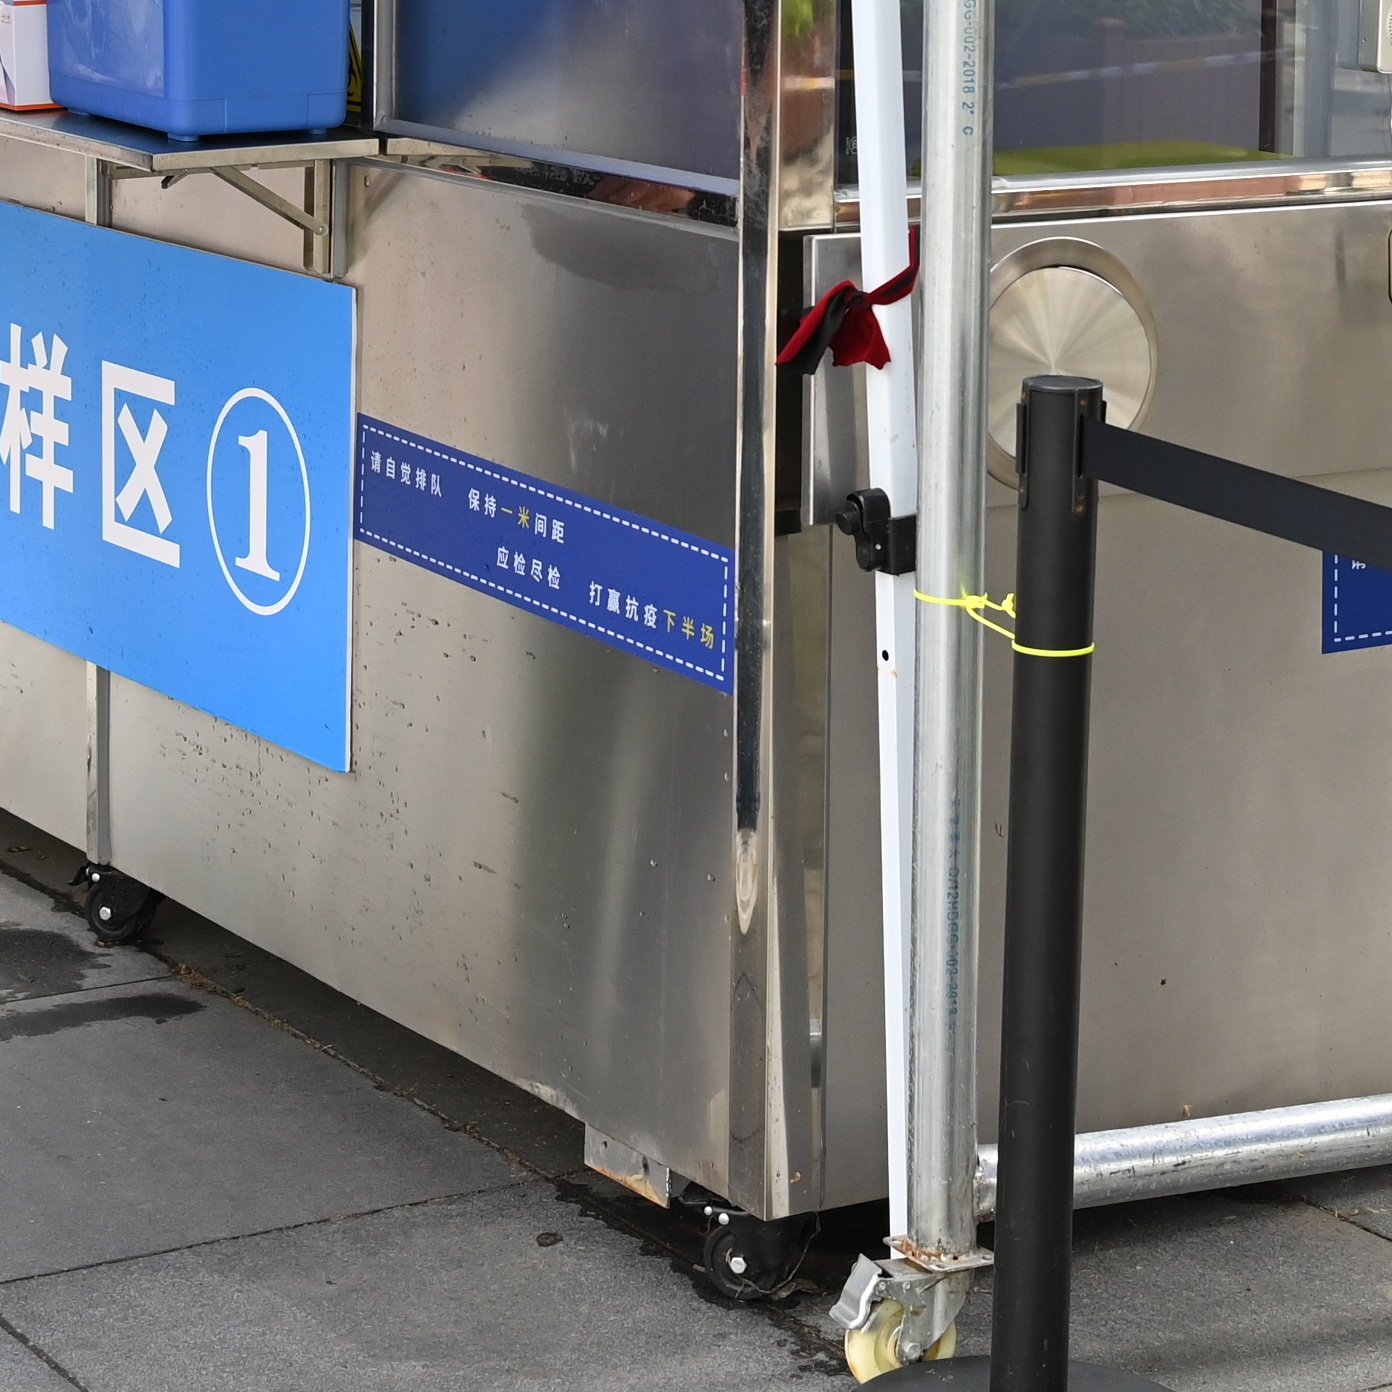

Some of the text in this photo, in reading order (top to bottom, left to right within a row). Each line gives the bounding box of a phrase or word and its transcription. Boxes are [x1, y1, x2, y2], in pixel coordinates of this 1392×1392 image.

[370, 450, 565, 543] 请自觉排队 保持一米间距
[496, 546, 715, 650] 应检尽检 打赢抗疫下半场
